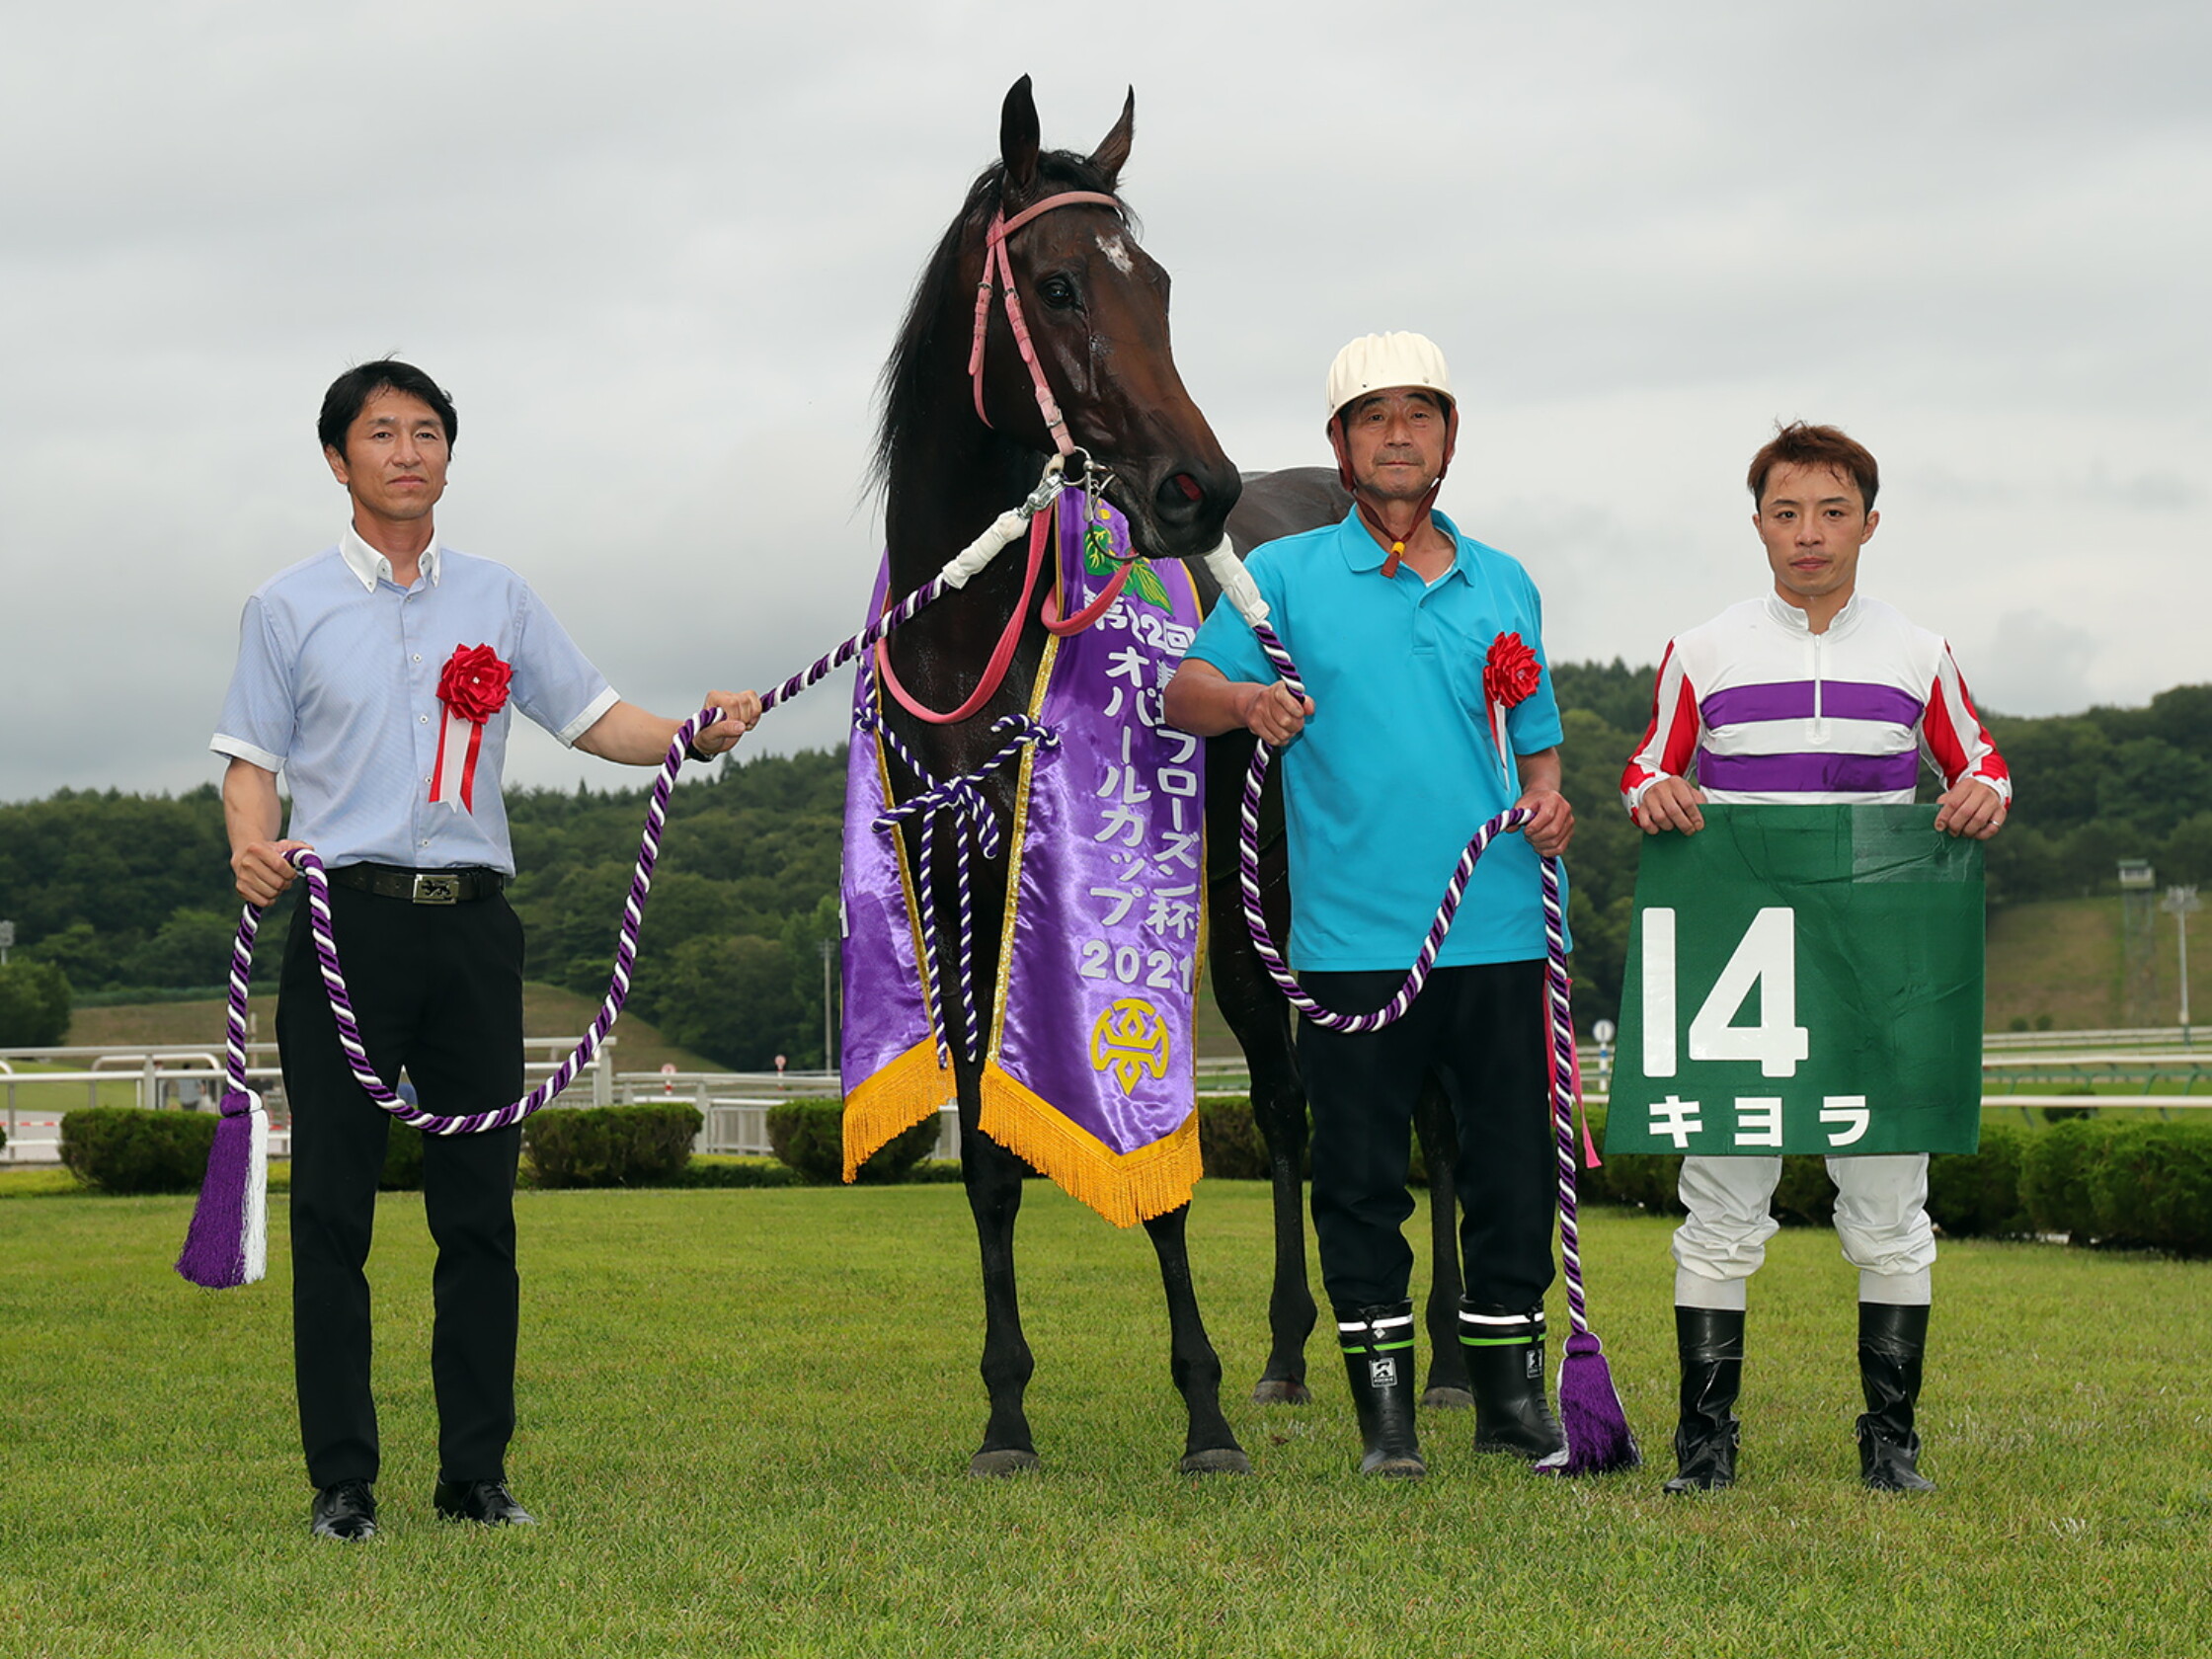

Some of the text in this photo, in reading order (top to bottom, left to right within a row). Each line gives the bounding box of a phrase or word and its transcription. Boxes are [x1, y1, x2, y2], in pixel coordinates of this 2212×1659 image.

[1090, 646, 1156, 925] オパールカップ
[1080, 940, 1192, 992] 2021
[1642, 907, 1808, 1077] 14
[1648, 1094, 1870, 1148] キヨラ
